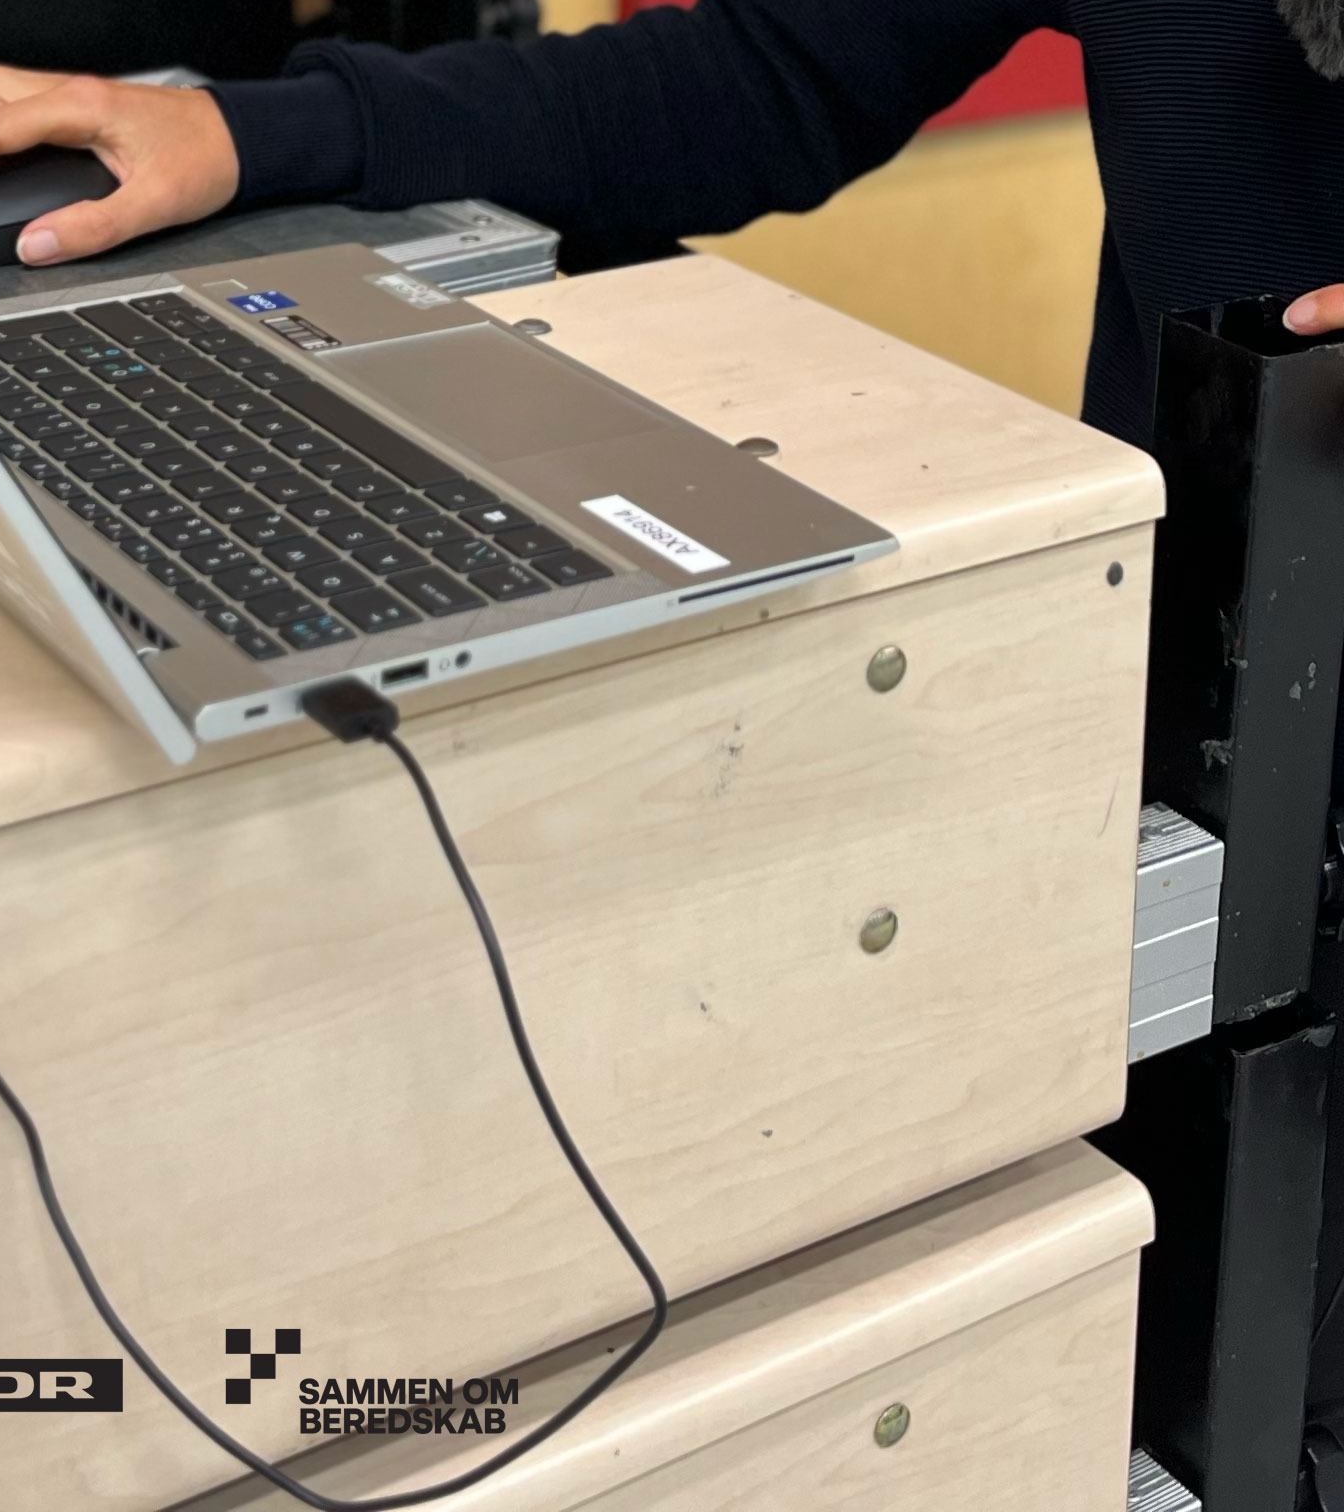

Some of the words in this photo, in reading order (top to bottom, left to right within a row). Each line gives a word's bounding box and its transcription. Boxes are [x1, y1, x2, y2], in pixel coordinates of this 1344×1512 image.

[62, 385, 78, 393] P
[86, 402, 102, 411] O
[165, 405, 182, 414] K
[236, 402, 254, 412] M
[194, 424, 211, 432] J
[266, 422, 283, 431] N
[140, 441, 157, 450] U
[221, 444, 238, 453] H
[297, 442, 314, 451] B
[167, 463, 183, 471] Y
[251, 465, 267, 474] G
[326, 463, 342, 472] V
[197, 485, 213, 493] T
[282, 488, 299, 496] F
[358, 484, 375, 493] C
[227, 505, 244, 514] R
[313, 508, 331, 517] D
[391, 506, 409, 515] X
[258, 528, 276, 537] E
[347, 531, 364, 540] S
[426, 529, 444, 538] Z
[612, 508, 701, 556] AX86914
[286, 549, 306, 561] W
[380, 554, 398, 564] A
[323, 576, 341, 586] Q
